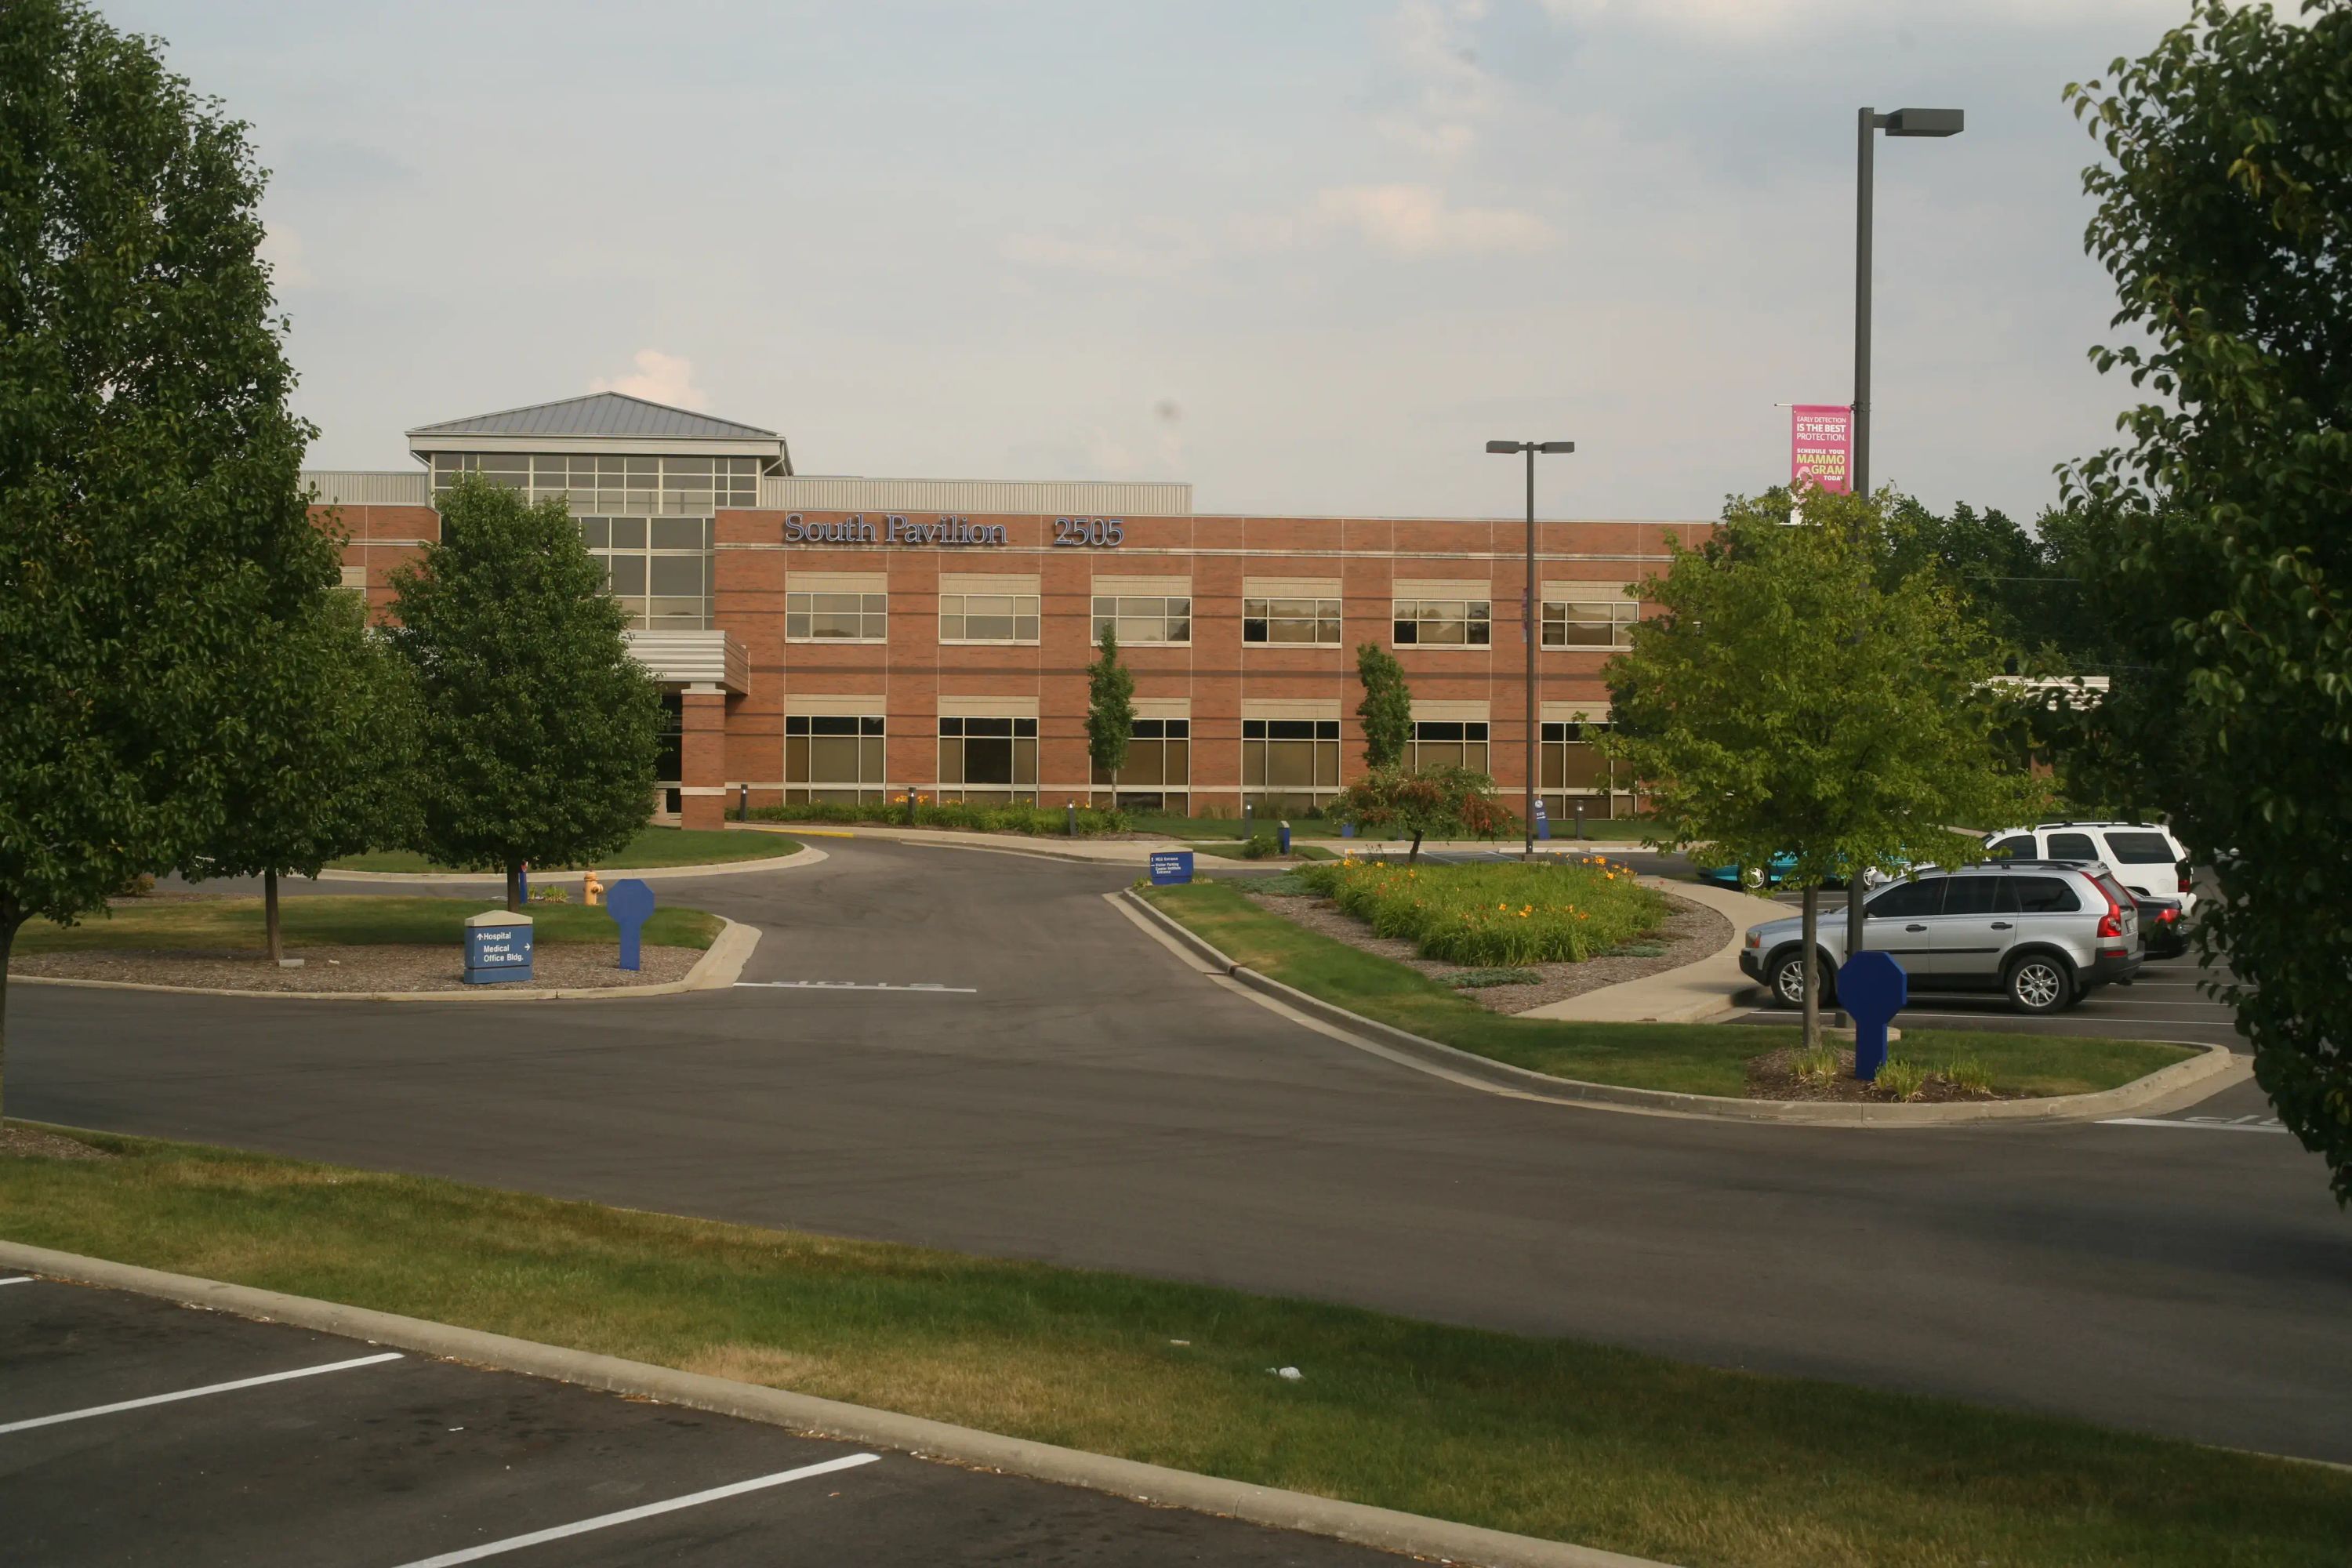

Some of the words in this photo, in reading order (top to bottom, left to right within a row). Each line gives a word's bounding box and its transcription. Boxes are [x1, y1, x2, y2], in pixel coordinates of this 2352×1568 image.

[1797, 454, 1845, 464] MAMMO
[1811, 465, 1845, 475] GRAM
[785, 514, 877, 543] South
[884, 514, 1008, 544] Pavilion
[1054, 517, 1123, 546] 2505
[484, 932, 511, 941] Hospital
[484, 944, 510, 953] Medical
[506, 953, 524, 962] Bldg.
